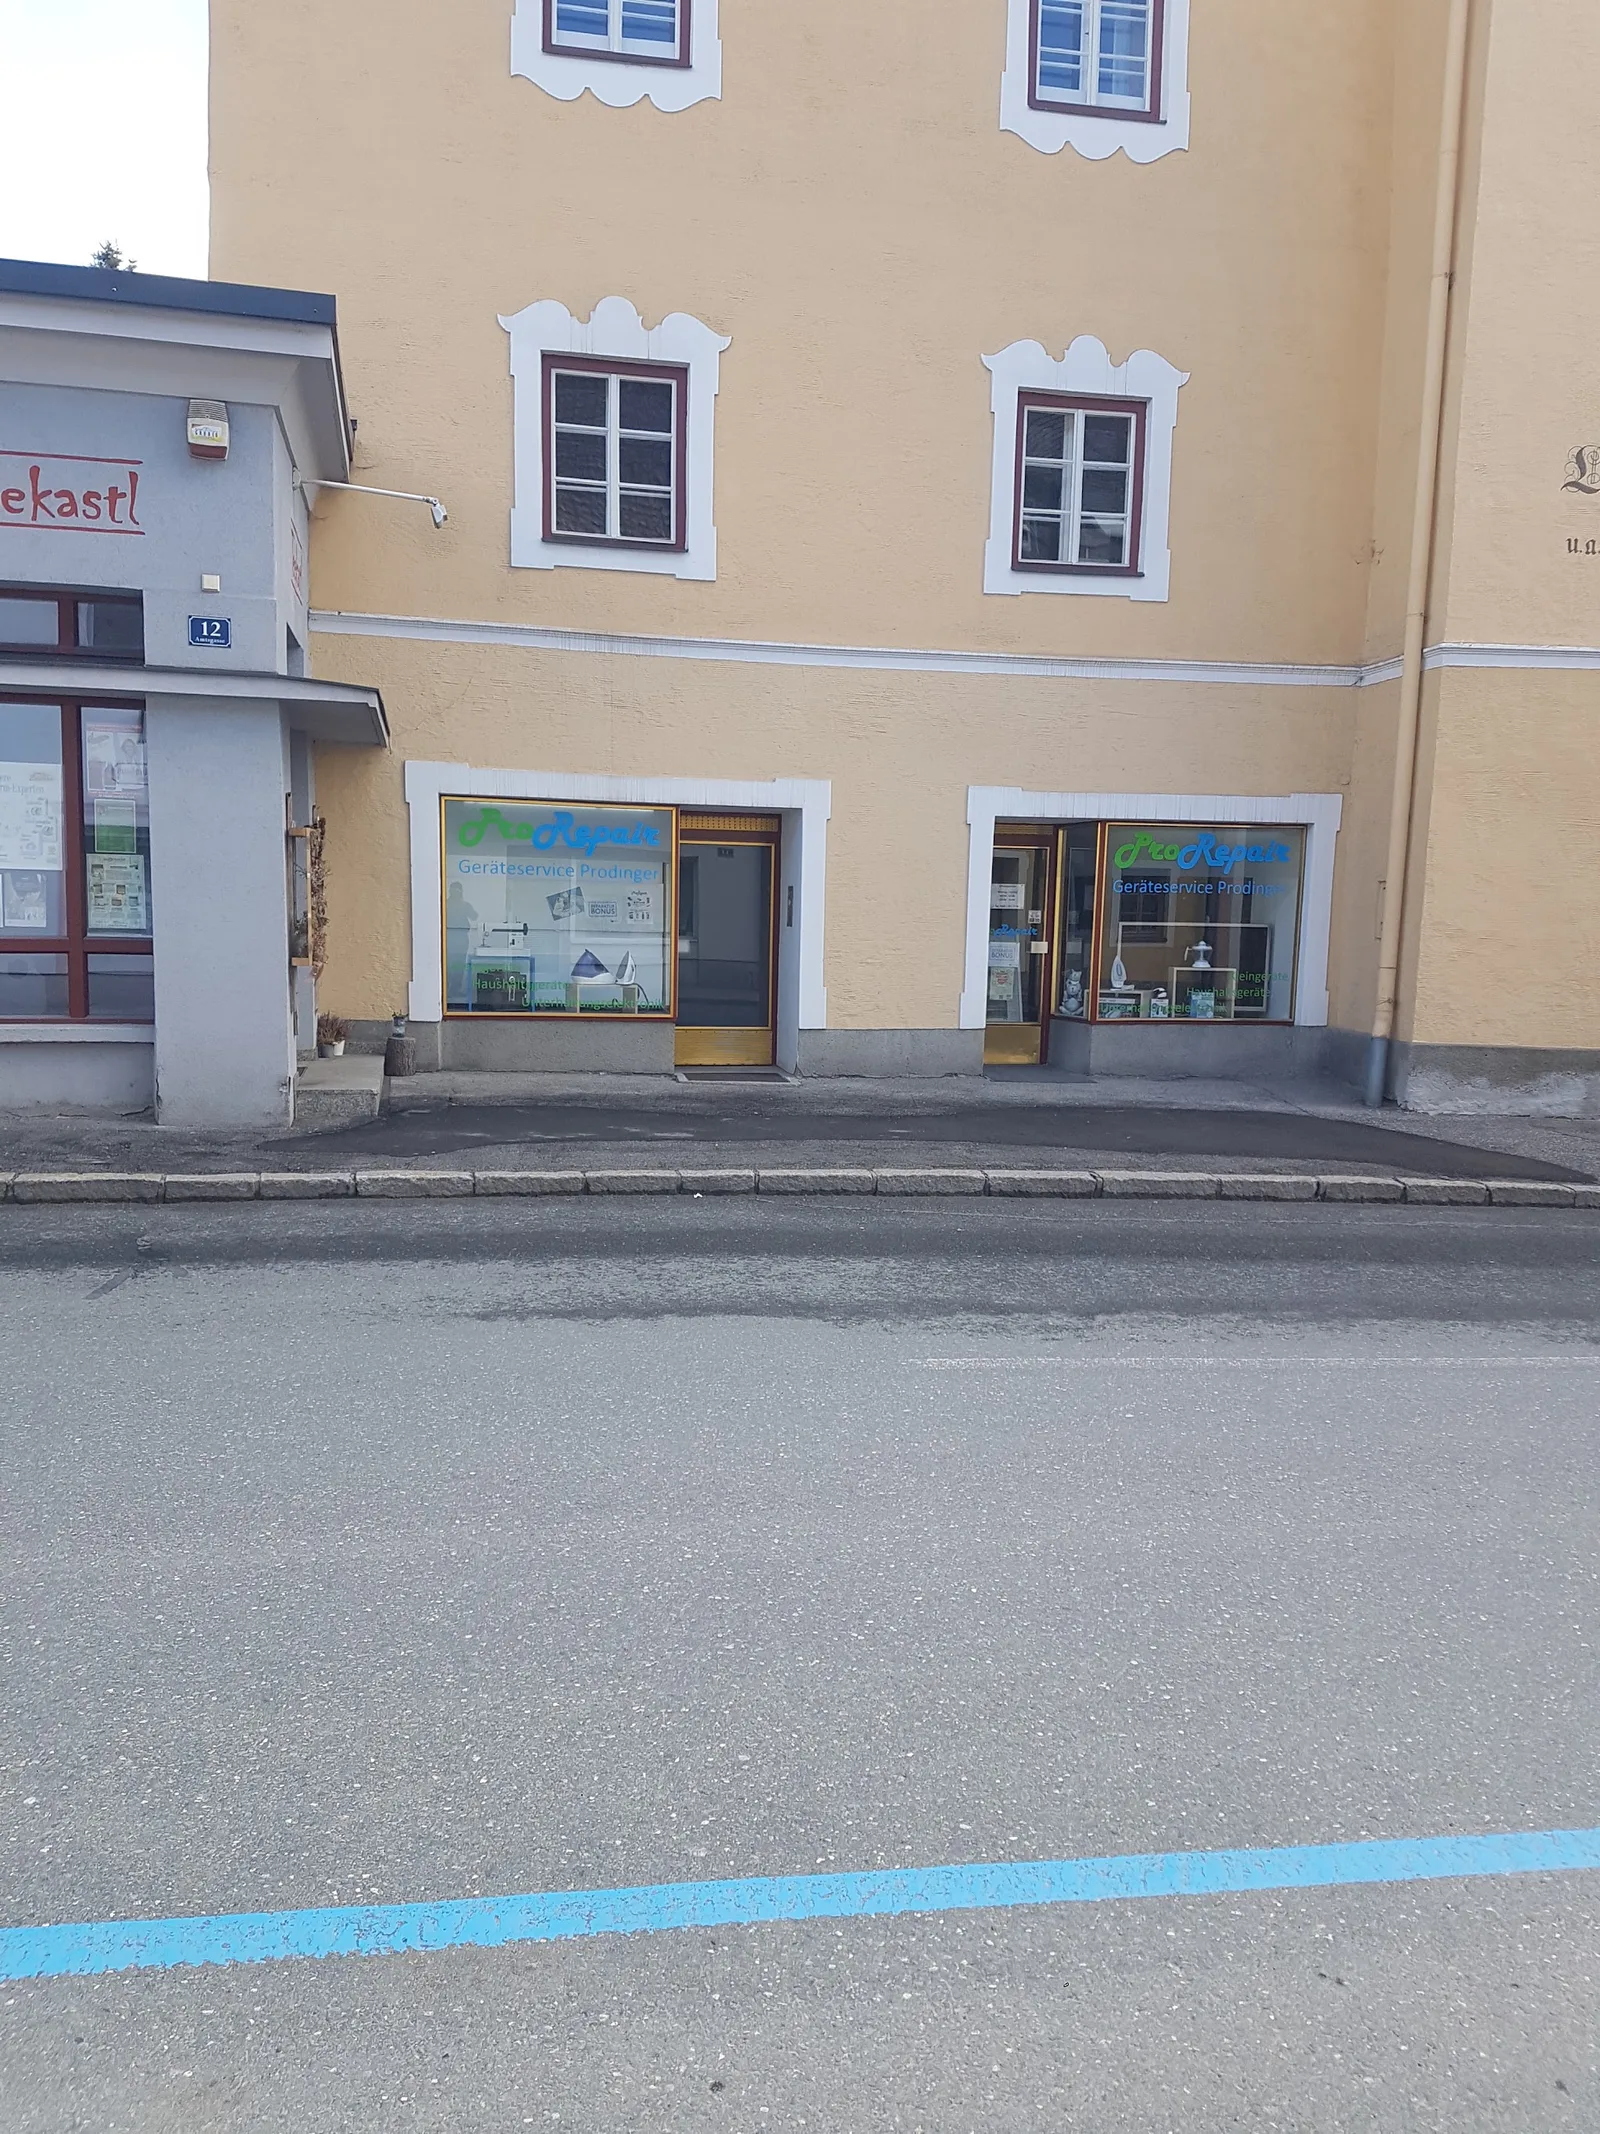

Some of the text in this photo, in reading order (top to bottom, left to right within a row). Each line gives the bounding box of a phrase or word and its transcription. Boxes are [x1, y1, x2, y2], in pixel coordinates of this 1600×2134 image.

[1, 465, 140, 525] ekastl
[201, 621, 222, 637] 12
[458, 807, 661, 857] ProRepair
[1114, 831, 1291, 875] ProRepair
[458, 859, 659, 884] Geräteservice Prodinger
[1112, 879, 1213, 895] Geräteservice
